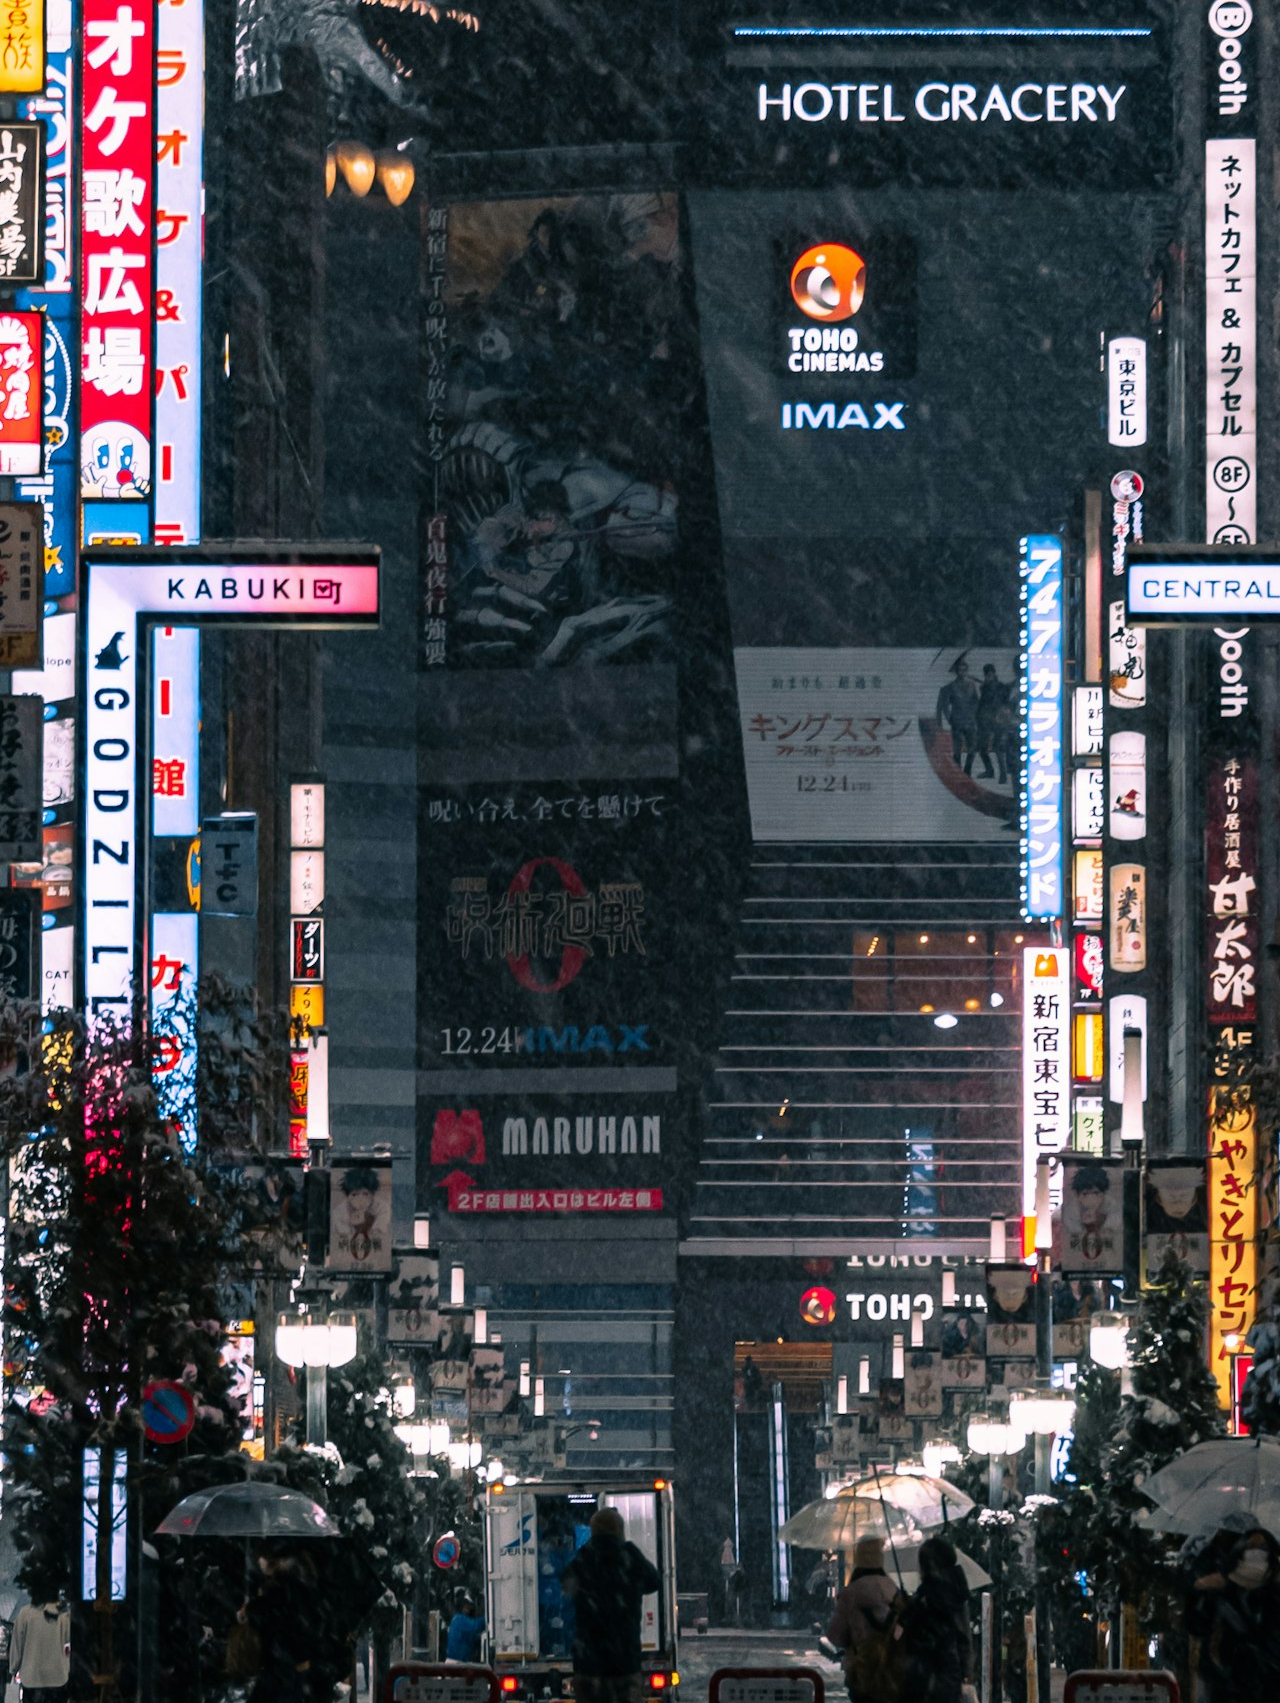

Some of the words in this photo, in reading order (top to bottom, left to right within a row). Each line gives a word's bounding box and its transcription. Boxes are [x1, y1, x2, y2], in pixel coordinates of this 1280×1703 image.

[758, 84, 905, 123] HOTEL
[915, 83, 1127, 123] GRACERY
[1220, 154, 1242, 295] ネットカフェ
[788, 328, 858, 352] TOHO
[1221, 308, 1242, 329] &
[788, 352, 884, 373] CINEMAS
[1118, 359, 1138, 437] 東京ビル
[1220, 342, 1242, 436] カプセル
[782, 402, 906, 430] IMAX
[1221, 465, 1243, 484] 8F
[425, 514, 448, 613] 百鬼夜行
[1028, 548, 1062, 655] 747
[424, 617, 447, 666] 強襲
[1217, 628, 1250, 718] ooth
[748, 712, 913, 742] キングスマン
[1028, 662, 1062, 902] カラオケランド
[428, 794, 665, 824] 呪い合え、全てを懸けて
[1223, 758, 1242, 869] 手作り居酒屋
[92, 687, 130, 1016] GODZILL
[304, 921, 321, 968] ダーツ
[446, 891, 647, 962] 呪術廻戦
[1209, 871, 1257, 1008] 甘太郎
[440, 1026, 513, 1055] 12.24
[502, 1115, 661, 1155] MARUHAN
[845, 1293, 934, 1322] TOHO
